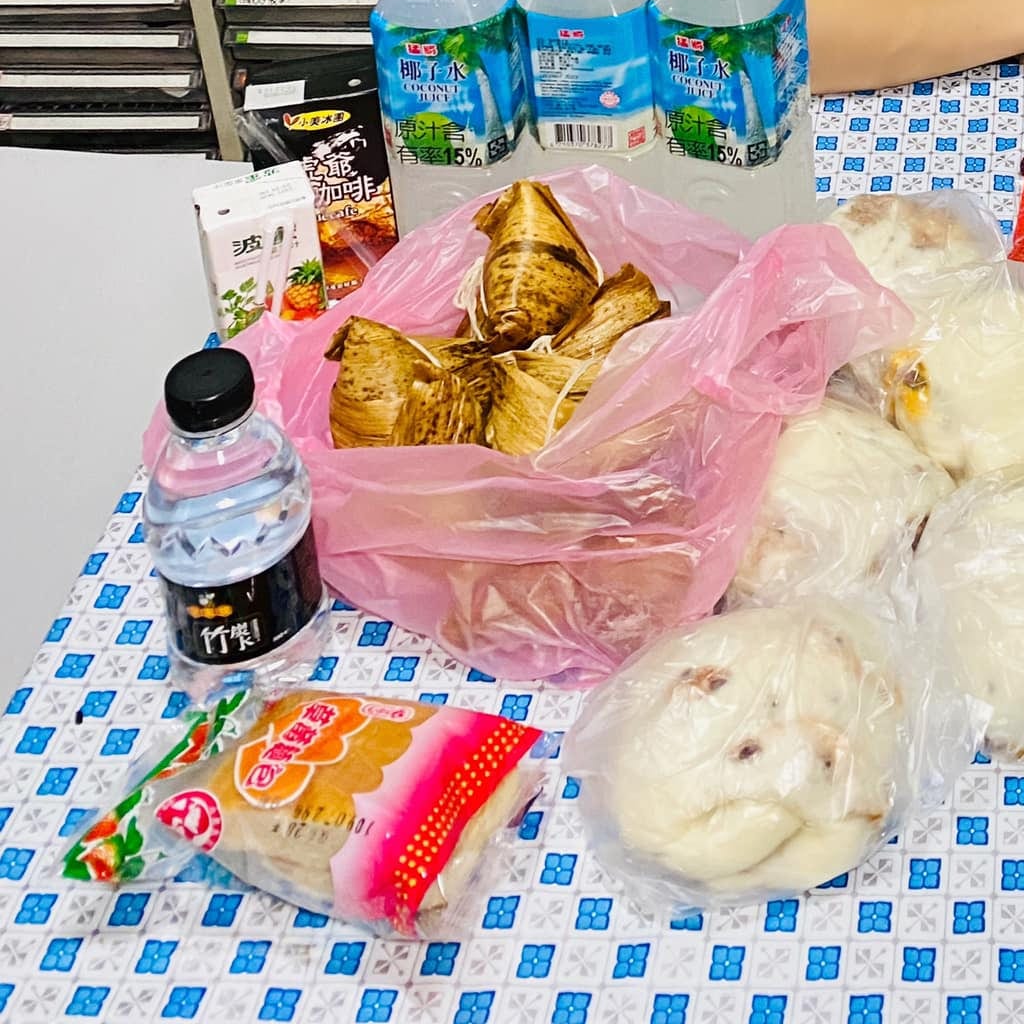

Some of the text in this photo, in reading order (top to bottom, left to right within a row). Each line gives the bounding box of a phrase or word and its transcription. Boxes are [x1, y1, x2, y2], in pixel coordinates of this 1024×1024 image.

[399, 59, 466, 81] 椰子水
[669, 50, 730, 79] 椰子水
[403, 83, 458, 93] COCONUT
[672, 75, 723, 90] COCONUT
[686, 88, 716, 98] JUICE
[419, 94, 450, 102] JUICE
[395, 119, 467, 142] 原汁含
[664, 109, 727, 141] 原汁含
[396, 145, 482, 166] 有率15%
[666, 137, 743, 166] 有率15%
